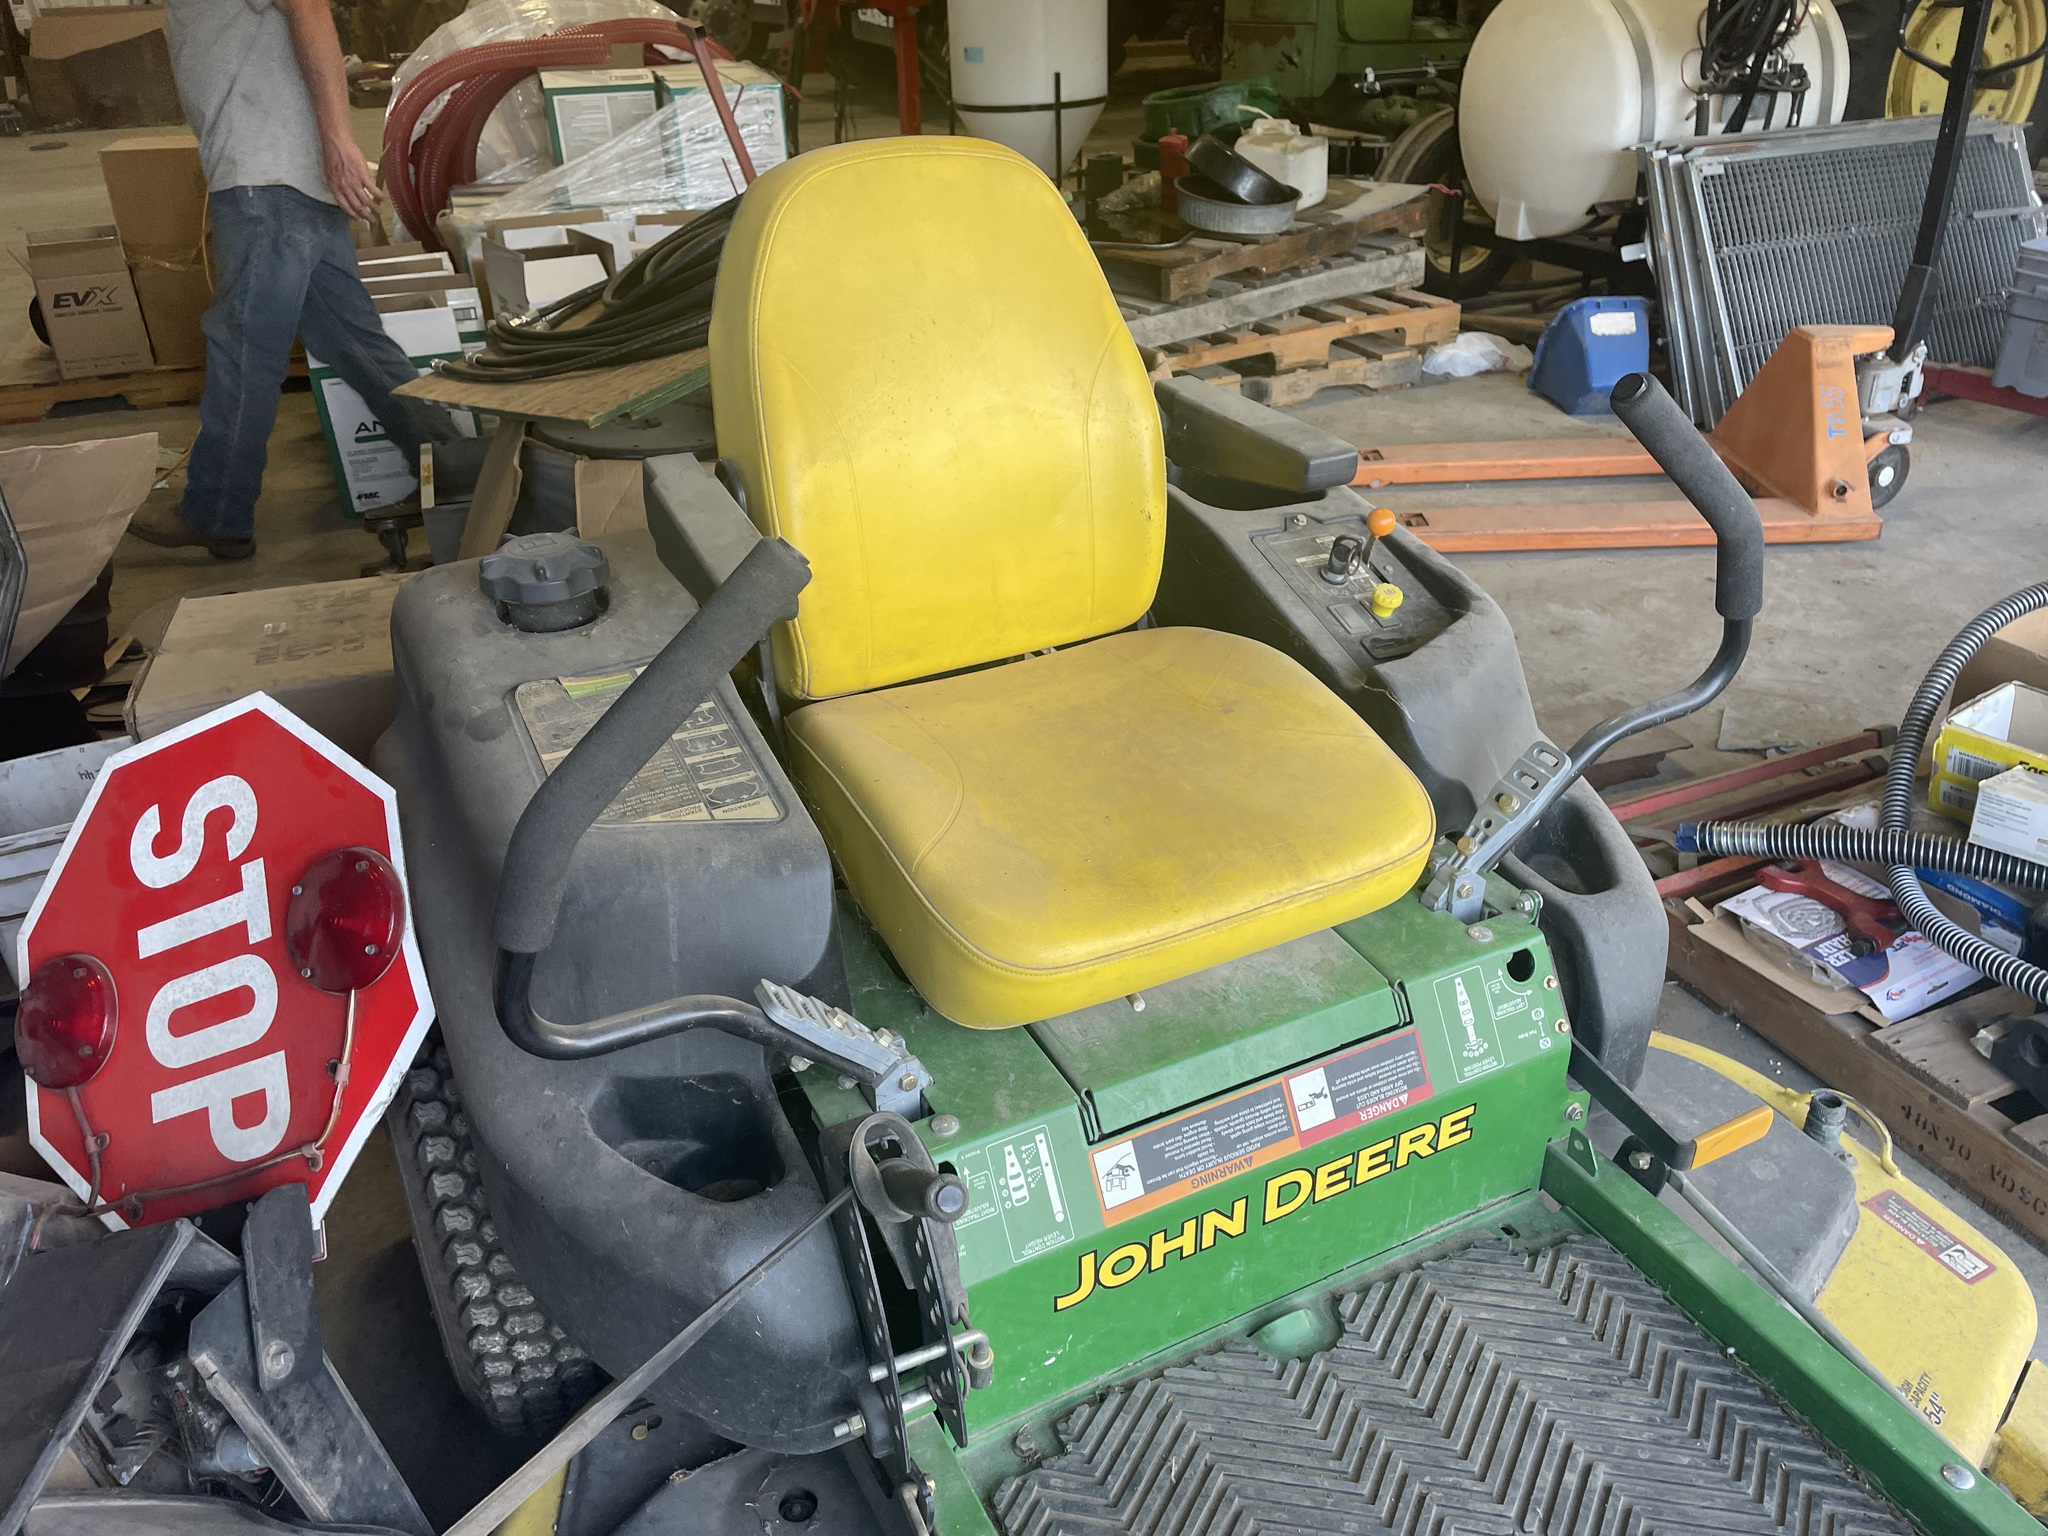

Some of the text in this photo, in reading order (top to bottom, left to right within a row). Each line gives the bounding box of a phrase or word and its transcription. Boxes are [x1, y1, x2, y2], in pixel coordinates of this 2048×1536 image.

[53, 286, 118, 309] EVX
[701, 749, 723, 759] Neutral
[659, 804, 700, 818] PROCEDURE
[722, 799, 760, 813] OPERATION
[1947, 883, 2003, 917] DIAMOND
[130, 774, 290, 1162] STOP
[1495, 1000, 1525, 1016] LEFT TRACKING
[1496, 997, 1522, 1011] ADJUSTMENT
[1393, 1052, 1404, 1060] carry
[1403, 1049, 1415, 1057] Never
[1379, 1057, 1394, 1067] children
[1396, 1058, 1407, 1066] down
[1463, 1055, 1495, 1072] LEVER POSITION
[1463, 1059, 1497, 1077] MOTION CONTROL
[1347, 1070, 1360, 1079] blades
[1359, 1066, 1370, 1074] while
[1363, 1070, 1376, 1079] before
[1376, 1065, 1388, 1074] behind
[1372, 1078, 1387, 1088] children
[1387, 1074, 1397, 1082] when
[1330, 1080, 1346, 1091] backing
[1355, 1085, 1368, 1094] others
[1356, 1078, 1403, 1101] OFF ARMS AND LEGS
[1334, 1093, 1349, 1102] around
[1355, 1083, 1408, 1109] ROTATING BLADES CUT
[1358, 1096, 1400, 1121] DANGER
[1163, 1136, 1212, 1158] Read operator's manual
[1185, 1147, 1201, 1156] sudden
[1200, 1142, 1213, 1150] Avoid
[1244, 1141, 1261, 1152] AVOID
[1222, 1147, 1245, 1161] SERIOUS
[1204, 1156, 1223, 1168] INJURY
[1178, 1167, 1196, 1178] DEATH
[1189, 1159, 1245, 1189] WARNING
[955, 1206, 995, 1225] RIGHT TRACKING
[1055, 1104, 1477, 1313] JOHN DEERE
[1882, 1212, 1916, 1240] DANGER
[1886, 1207, 1938, 1248] ROTATING BLADE
[1020, 1234, 1065, 1256] MOTION CONTROL
[1023, 1230, 1060, 1249] LEVER HEIGHT
[1923, 1391, 1949, 1425] 54"
